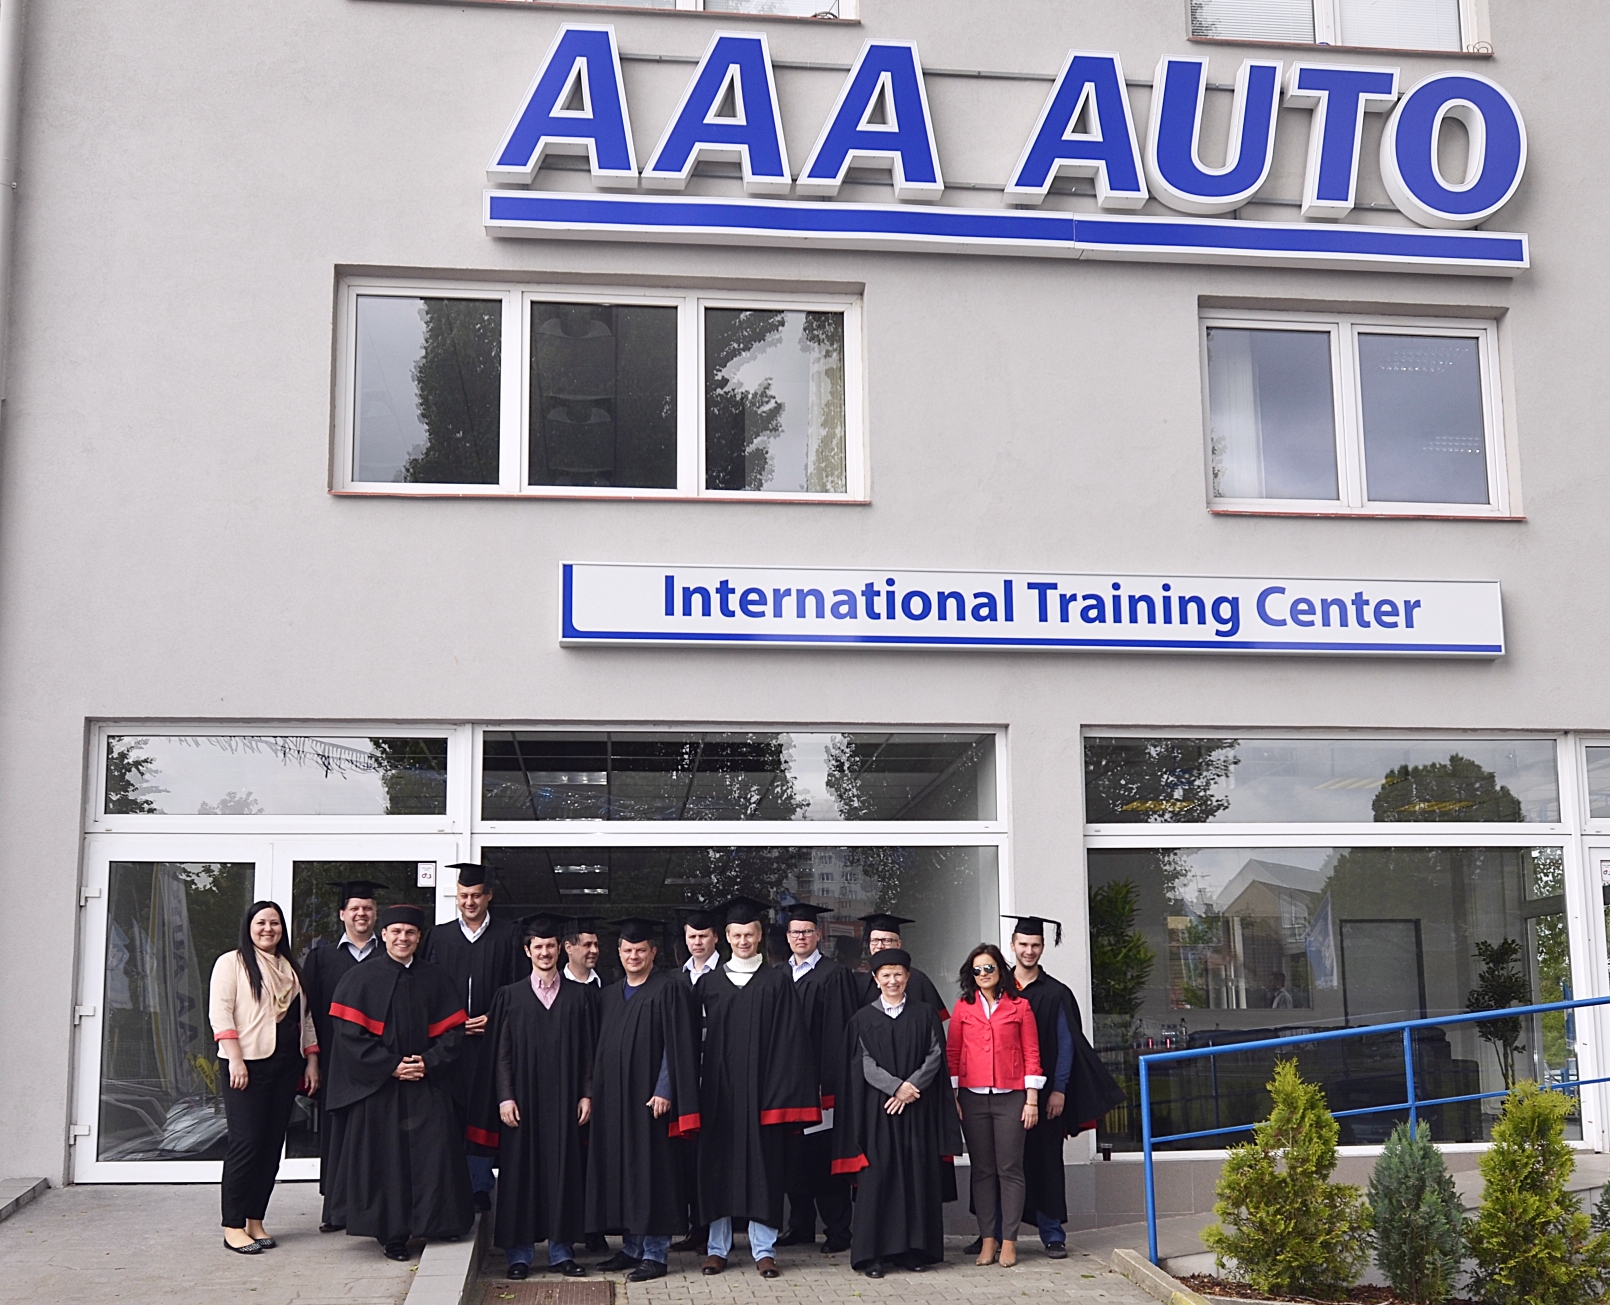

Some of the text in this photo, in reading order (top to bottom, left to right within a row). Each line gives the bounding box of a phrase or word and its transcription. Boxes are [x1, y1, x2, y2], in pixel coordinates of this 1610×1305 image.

[490, 26, 1527, 222] AAA AUTO
[664, 574, 1421, 638] International Training Center
